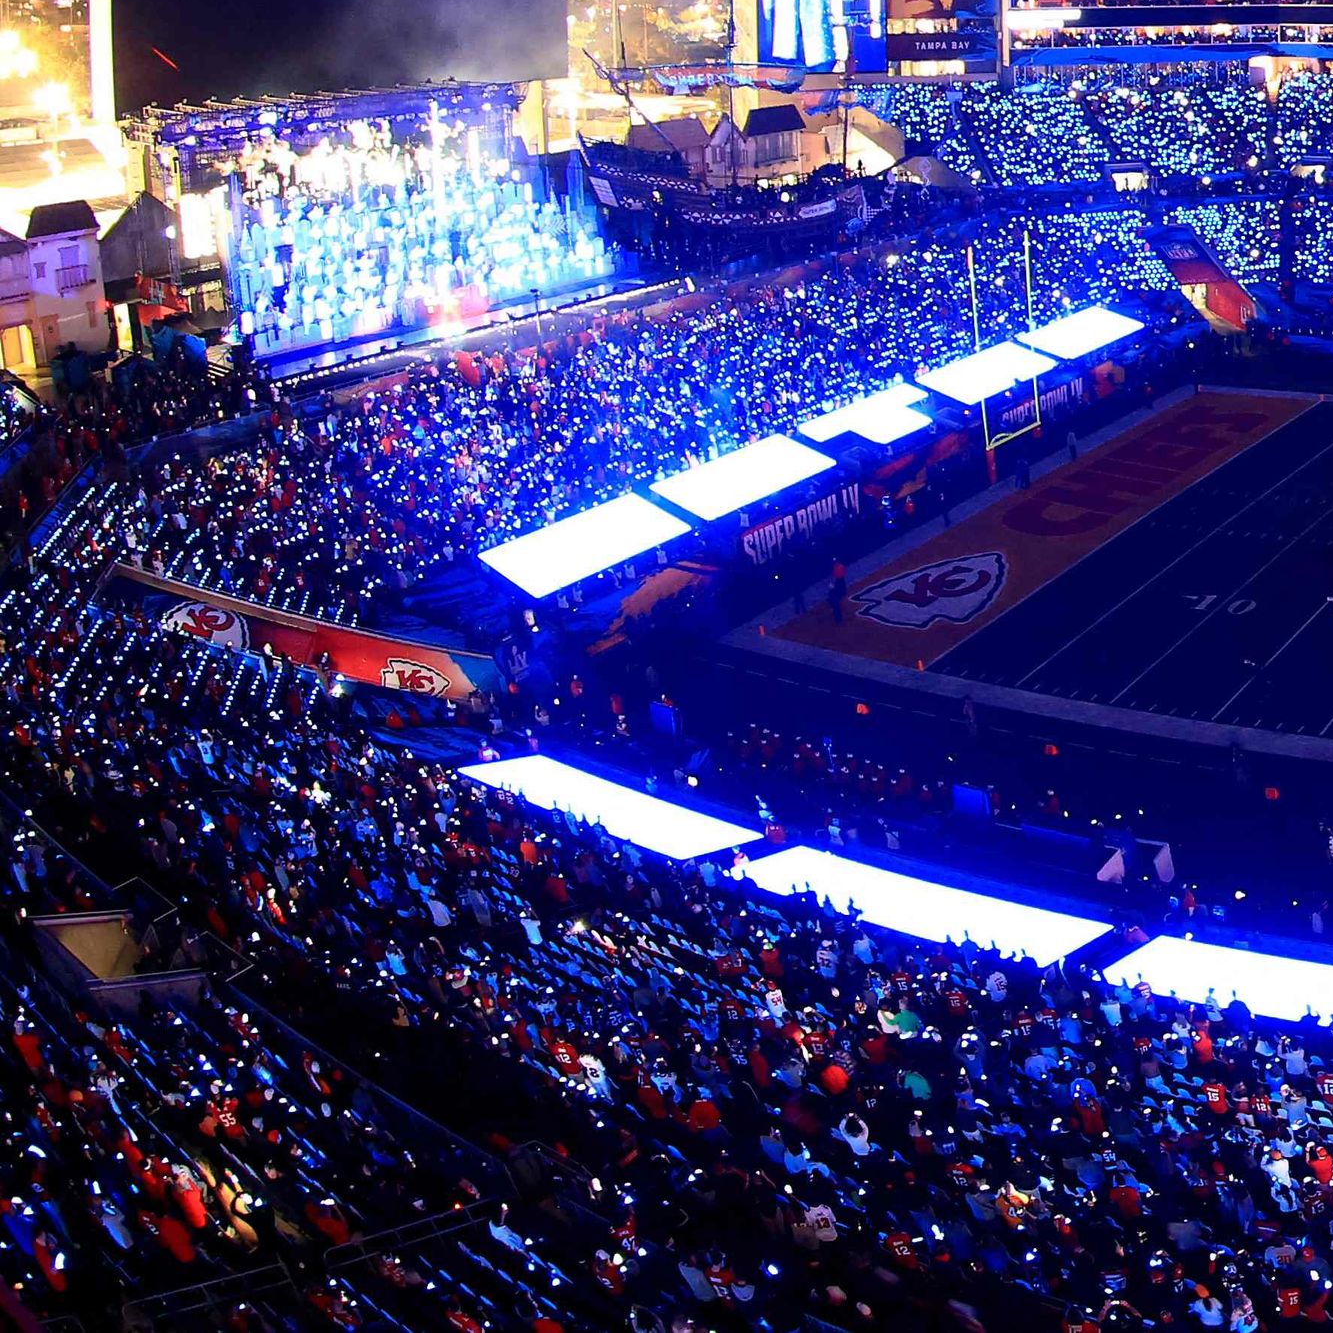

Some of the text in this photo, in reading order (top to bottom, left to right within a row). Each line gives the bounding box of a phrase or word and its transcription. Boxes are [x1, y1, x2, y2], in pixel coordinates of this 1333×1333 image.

[915, 41, 970, 50] TAMPA BAY
[884, 566, 991, 608] KC
[1192, 593, 1257, 615] 10
[1206, 1091, 1219, 1103] 15
[219, 1112, 237, 1127] 55
[895, 1245, 910, 1257] 12
